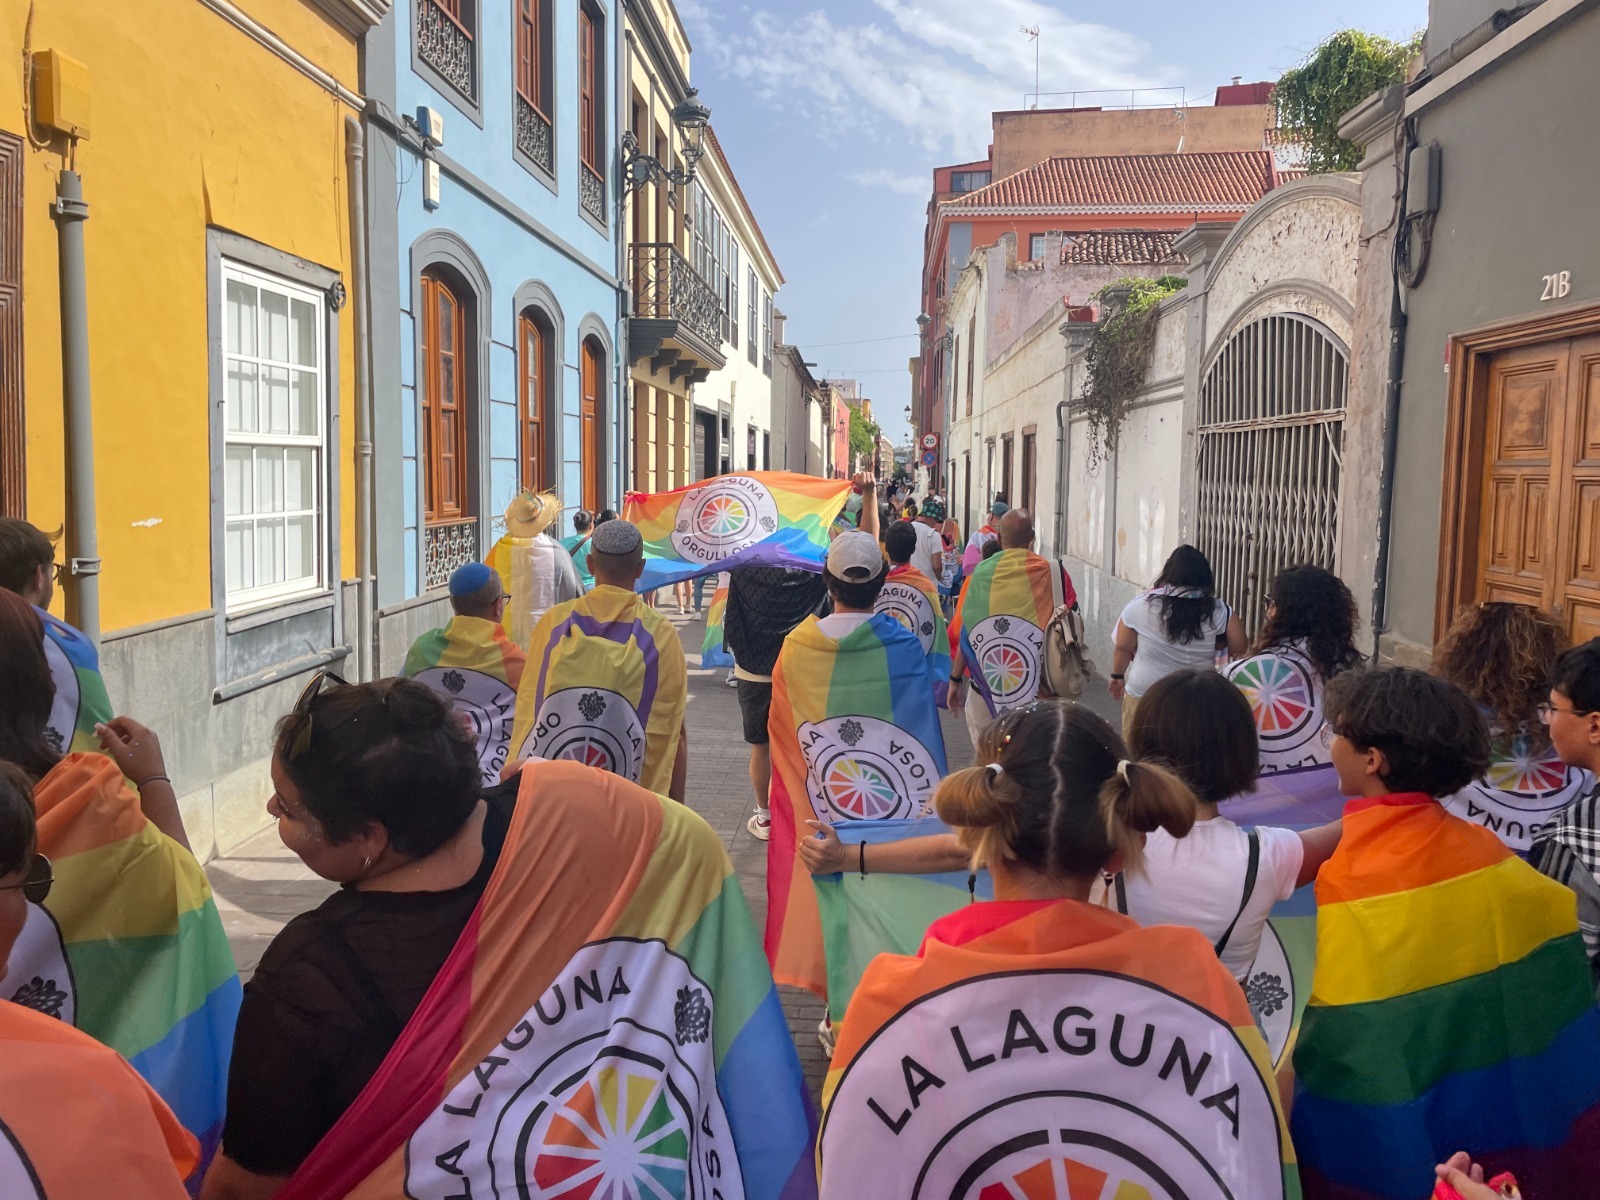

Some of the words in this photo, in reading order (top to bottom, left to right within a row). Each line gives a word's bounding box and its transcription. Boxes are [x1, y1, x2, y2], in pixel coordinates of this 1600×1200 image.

[1540, 270, 1571, 301] 21B
[925, 437, 935, 445] 20
[878, 587, 923, 609] AGUNA
[491, 693, 510, 716] LA
[483, 717, 514, 783] LAGUN
[1467, 799, 1542, 839] GUNA
[442, 966, 631, 1118] LAGUNA
[866, 1055, 946, 1136] LA
[950, 1005, 1240, 1140] LAGUNA
[435, 1139, 473, 1200] LA
